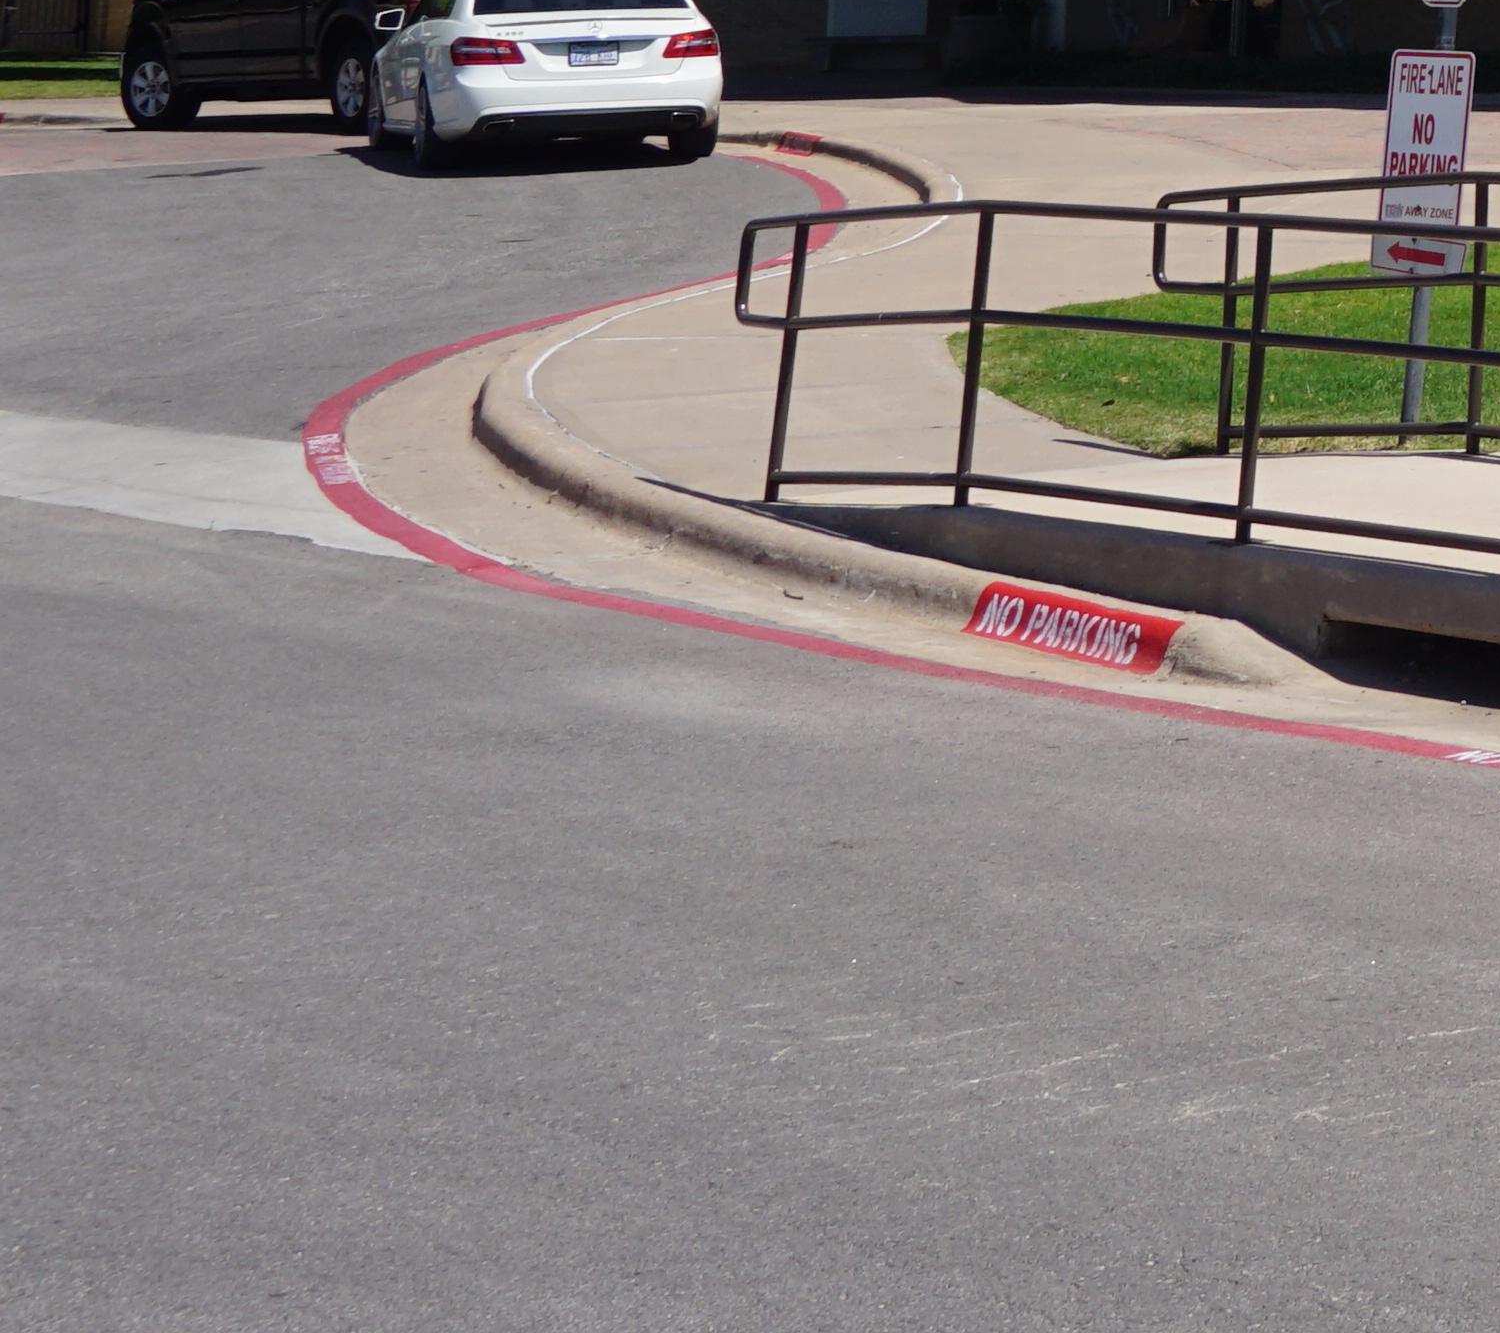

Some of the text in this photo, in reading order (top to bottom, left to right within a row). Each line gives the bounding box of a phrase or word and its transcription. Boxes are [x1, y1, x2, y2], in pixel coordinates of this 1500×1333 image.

[1399, 63, 1464, 96] FIRE LANE
[1412, 113, 1435, 145] NO
[1389, 152, 1458, 175] PARKING
[1404, 206, 1428, 216] AWAY
[1430, 207, 1454, 219] ZONE
[975, 593, 1141, 665] NO PARKING
